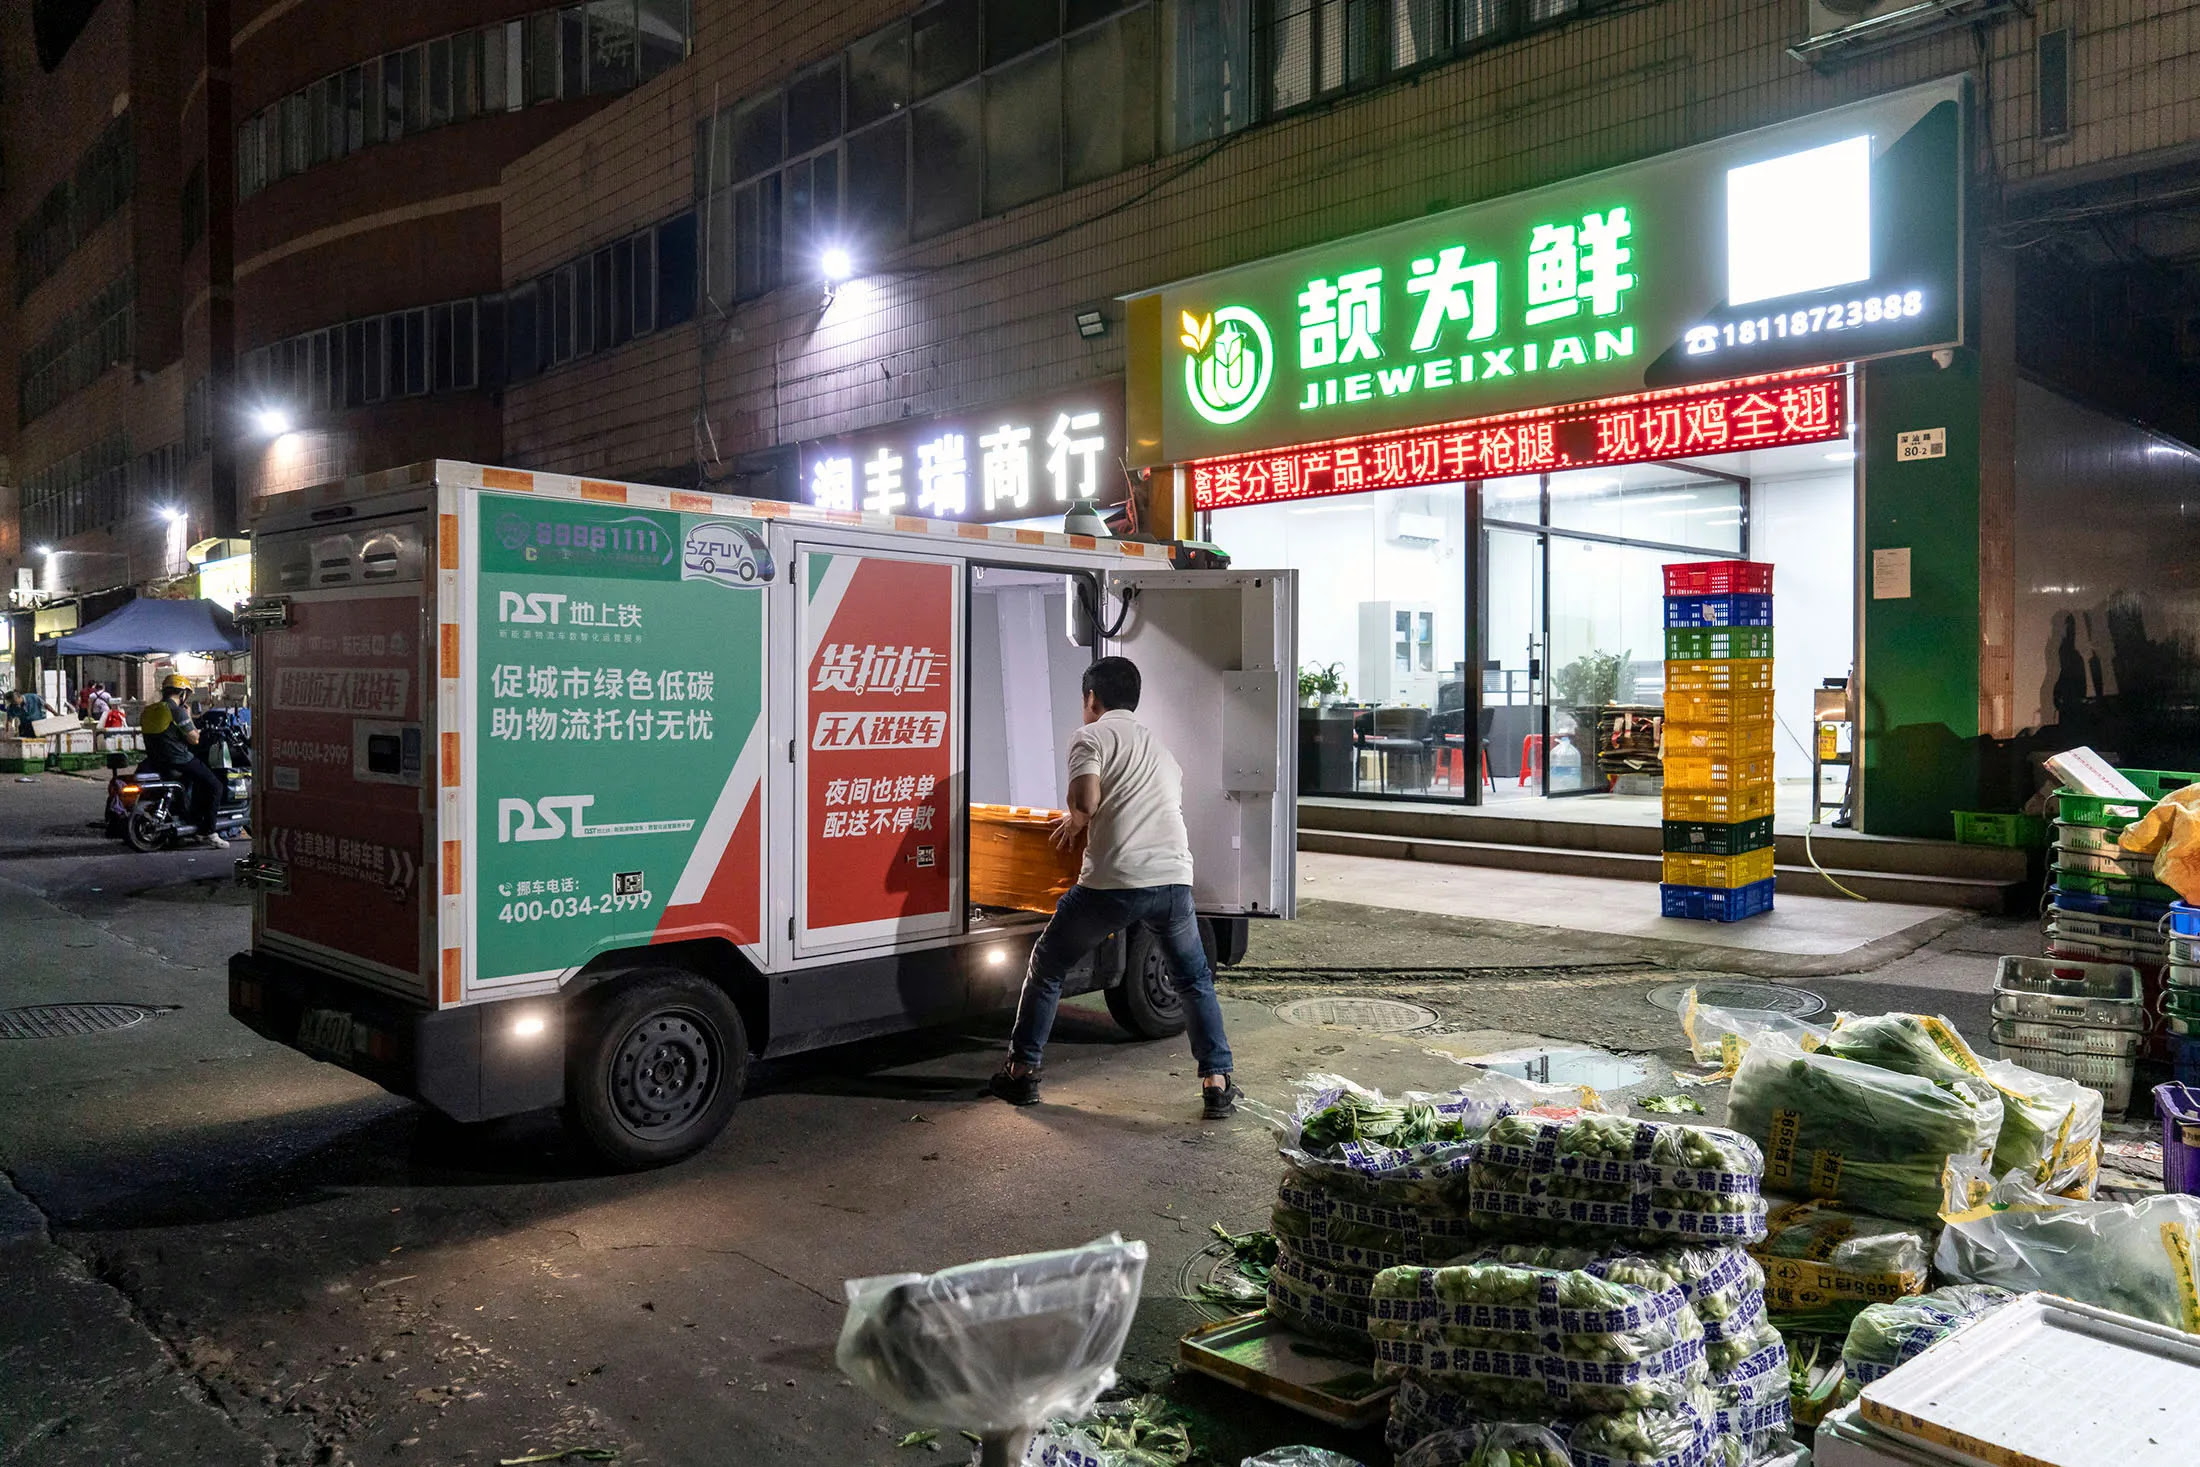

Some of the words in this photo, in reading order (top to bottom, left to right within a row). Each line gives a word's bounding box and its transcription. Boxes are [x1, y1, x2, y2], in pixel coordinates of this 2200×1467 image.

[1298, 207, 1634, 369] 颉为鲜
[1723, 290, 1923, 347] 18118723888
[1300, 327, 1634, 410] JIEWEIXIAN
[569, 600, 643, 628] 地上铁
[490, 663, 715, 702] 促城市绿色低碳
[812, 643, 948, 697] 货拉拉
[490, 707, 714, 741] 助物流托付无忧
[819, 715, 941, 747] 无人送货车
[825, 774, 936, 806] 夜间也接单
[822, 806, 936, 839] 配送不停歇
[499, 890, 653, 923] 400-034-2999
[1455, 1303, 1532, 1331] 精品蔬菜
[1561, 1305, 1641, 1333] 精品蔬菜
